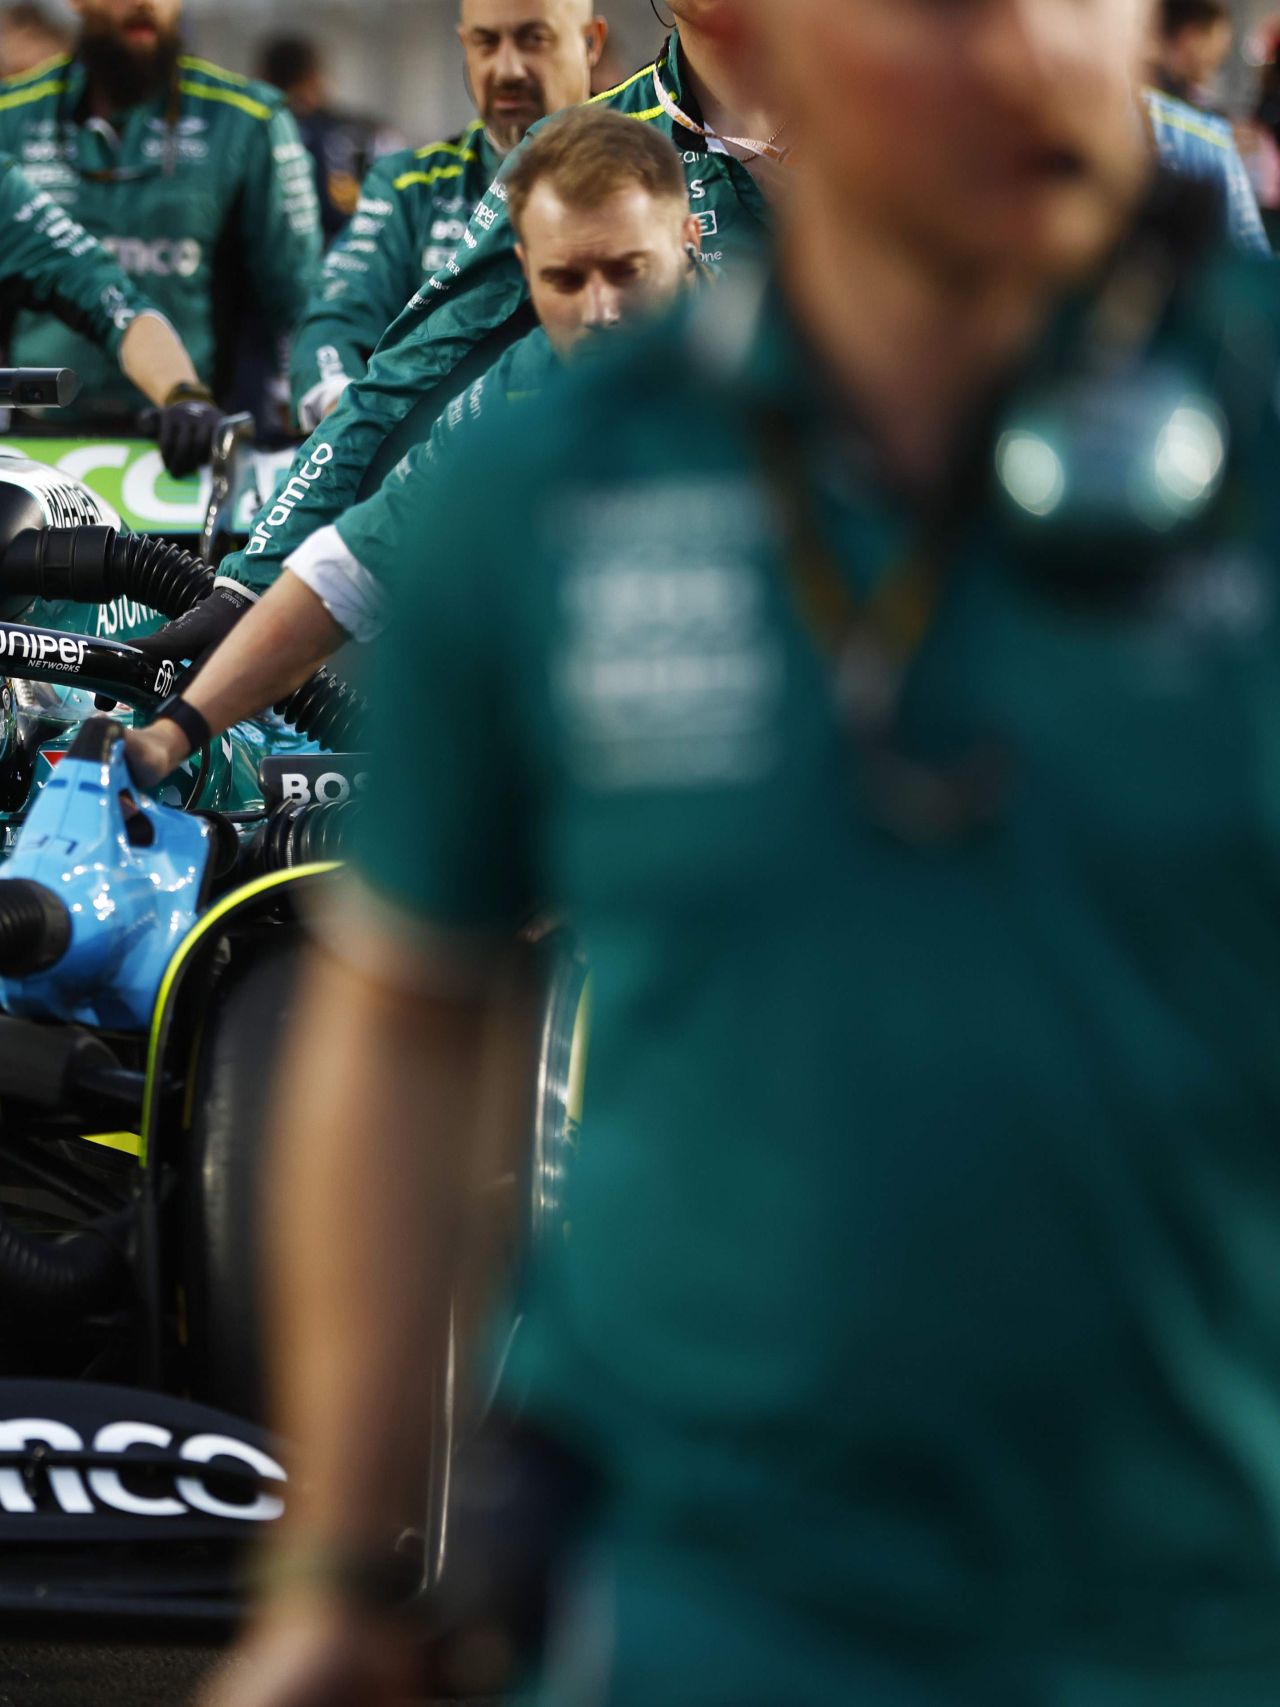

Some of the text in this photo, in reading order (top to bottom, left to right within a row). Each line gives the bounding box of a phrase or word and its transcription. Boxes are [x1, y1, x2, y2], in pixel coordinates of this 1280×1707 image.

[245, 442, 333, 555] aramco
[28, 659, 81, 673] NETWORKS
[282, 771, 370, 807] BO
